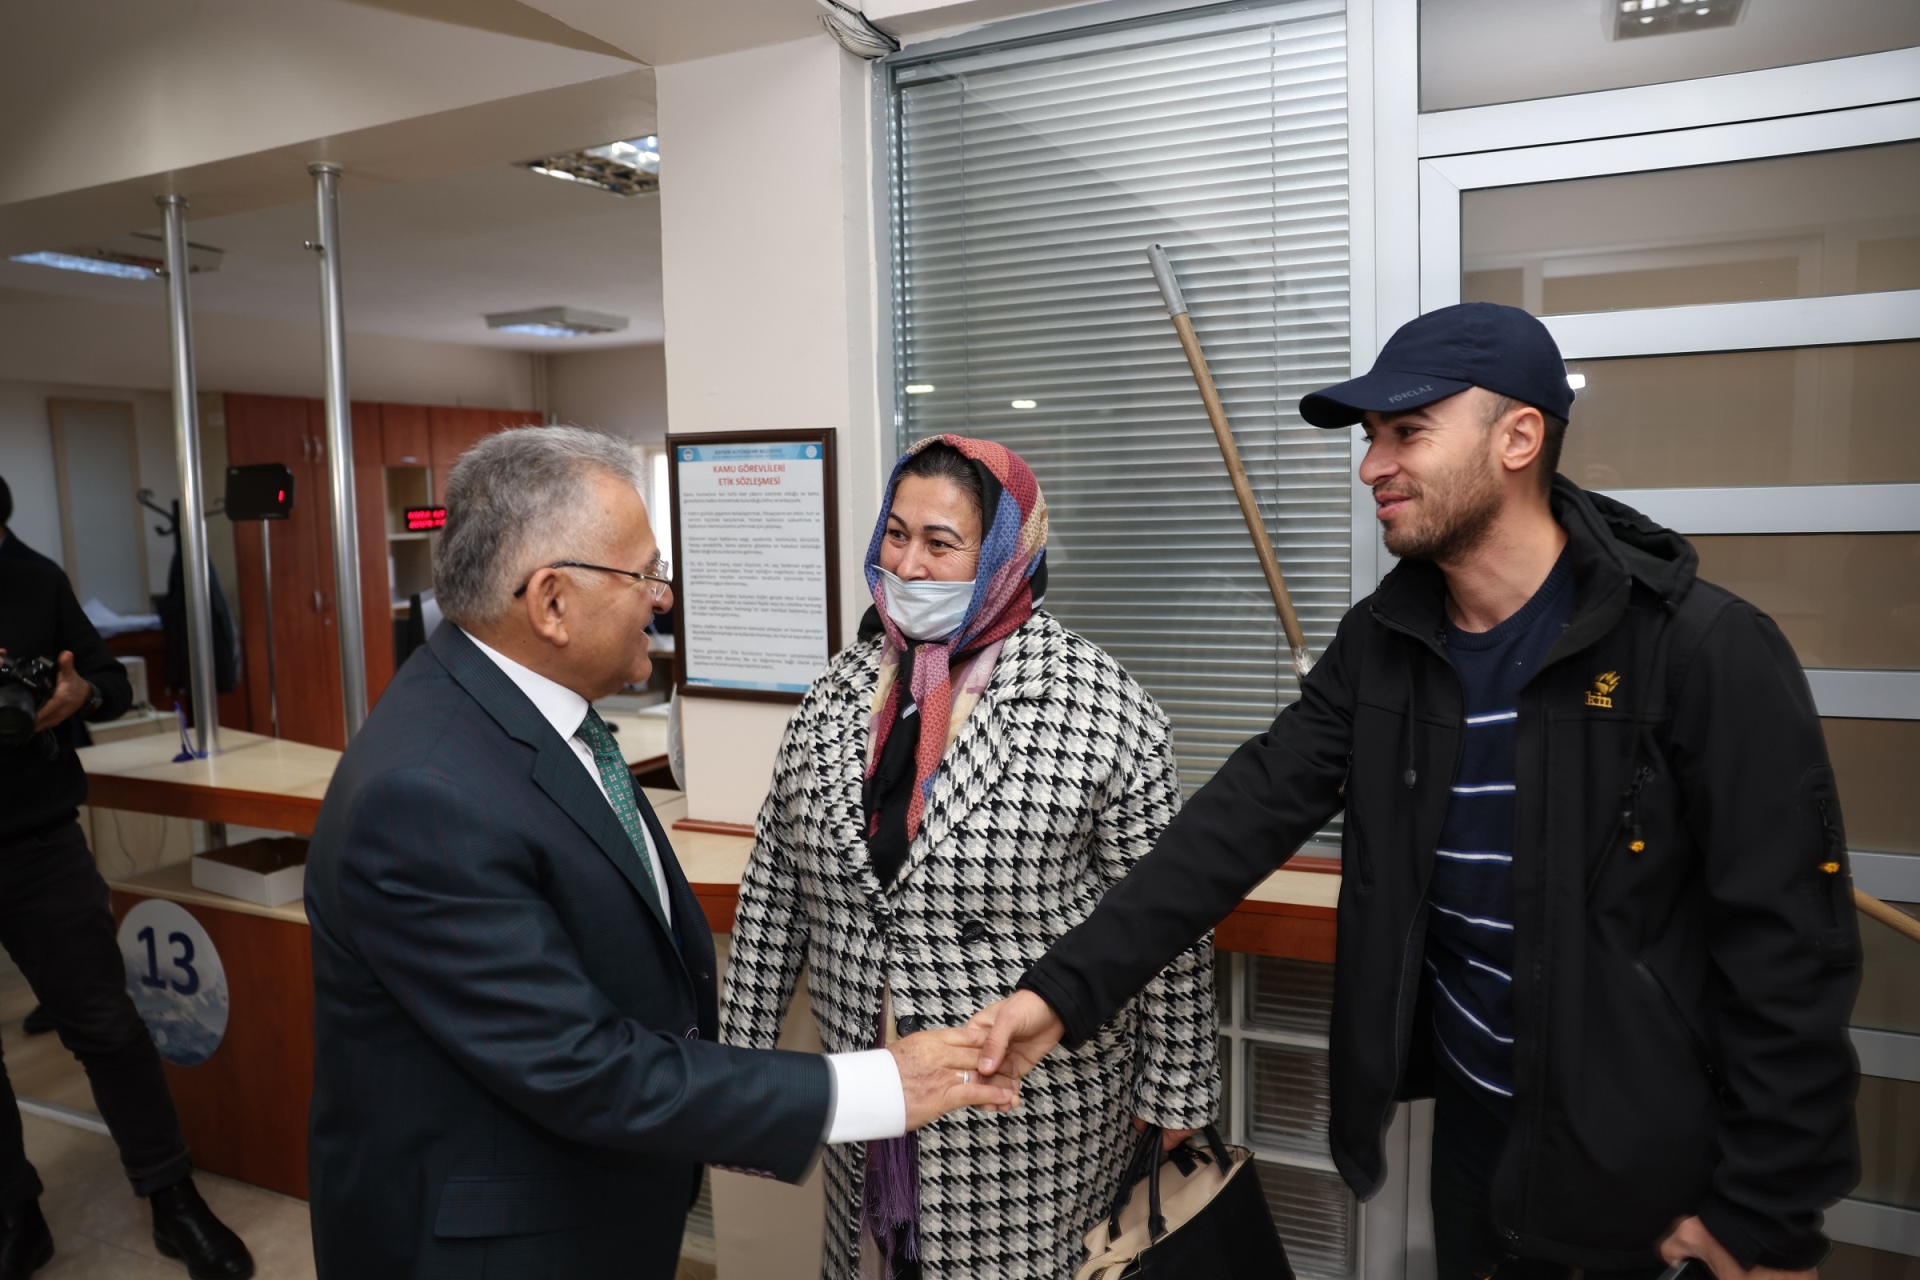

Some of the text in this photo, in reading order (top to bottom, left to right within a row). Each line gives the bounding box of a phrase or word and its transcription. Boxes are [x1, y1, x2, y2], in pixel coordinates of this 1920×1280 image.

[1388, 384, 1434, 404] FORCLAZ
[713, 463, 786, 473] KAMU GÖREVLİLERİ
[718, 476, 781, 487] ETİK SÖZLEŞMESİ
[137, 925, 200, 997] 13
